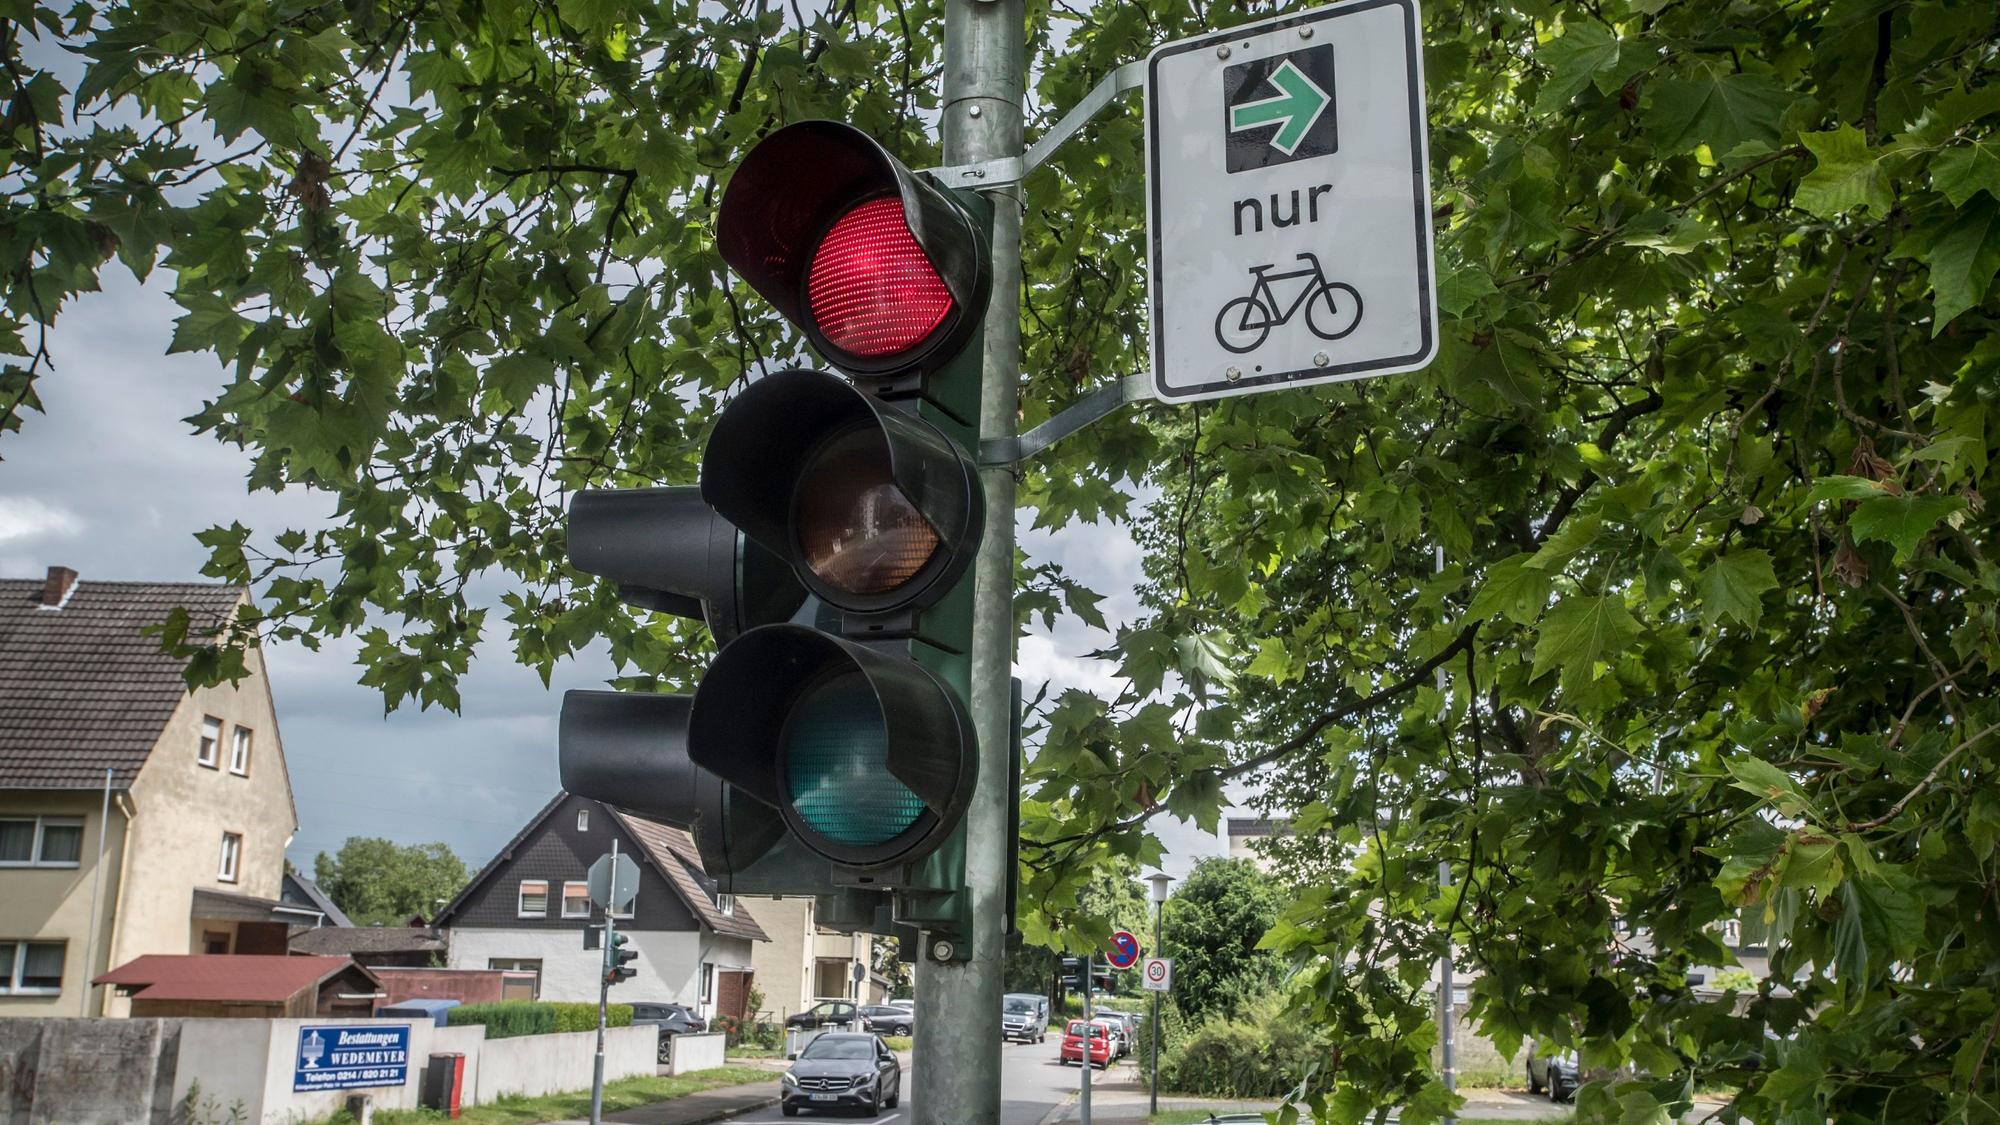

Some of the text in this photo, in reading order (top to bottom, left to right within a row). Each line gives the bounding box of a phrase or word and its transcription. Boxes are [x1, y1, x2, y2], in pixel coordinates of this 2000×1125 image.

[1233, 183, 1333, 236] nur
[1152, 966, 1161, 976] 30
[338, 1031, 399, 1046] Bestattungen
[331, 1051, 405, 1065] WEDEMEYER
[305, 1073, 335, 1082] Telefon
[336, 1071, 357, 1080] 0214
